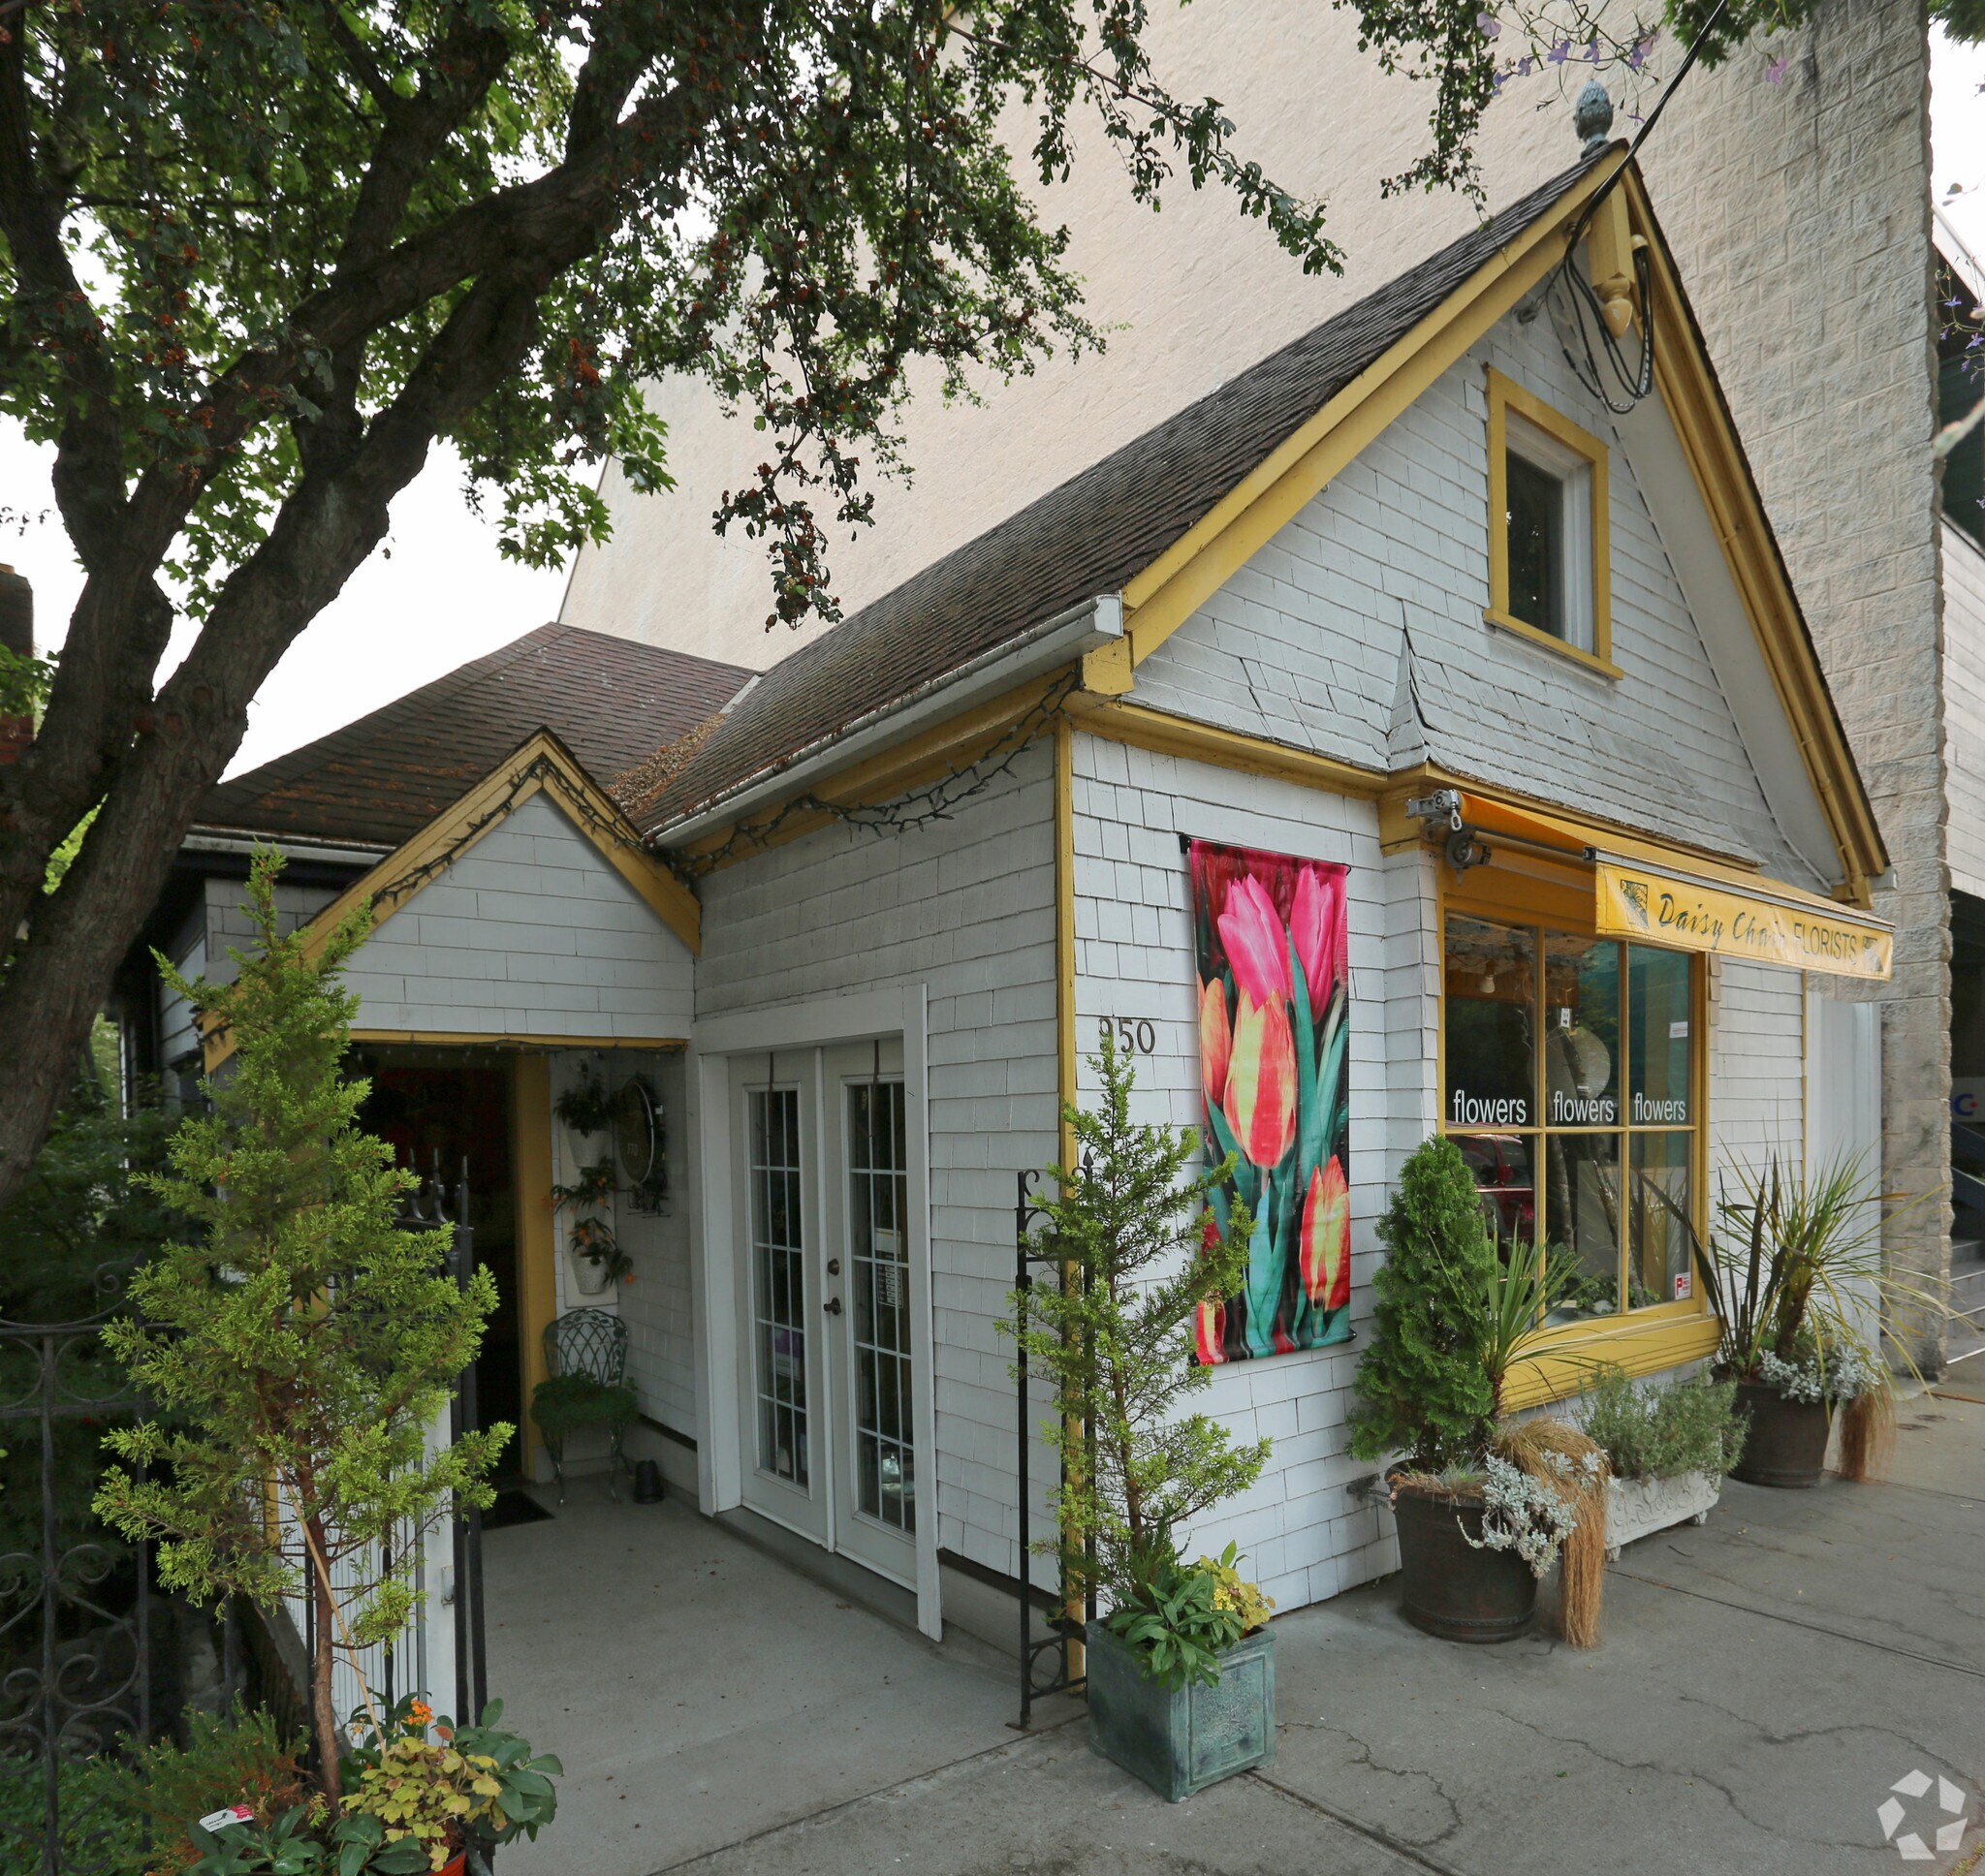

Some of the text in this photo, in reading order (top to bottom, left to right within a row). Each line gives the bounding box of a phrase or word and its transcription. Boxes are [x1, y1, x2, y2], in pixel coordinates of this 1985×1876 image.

[1658, 892, 1725, 950] Daisy
[1793, 922, 1858, 965] FLORISTS
[1453, 1089, 1686, 1124] flowers flowers flowers
